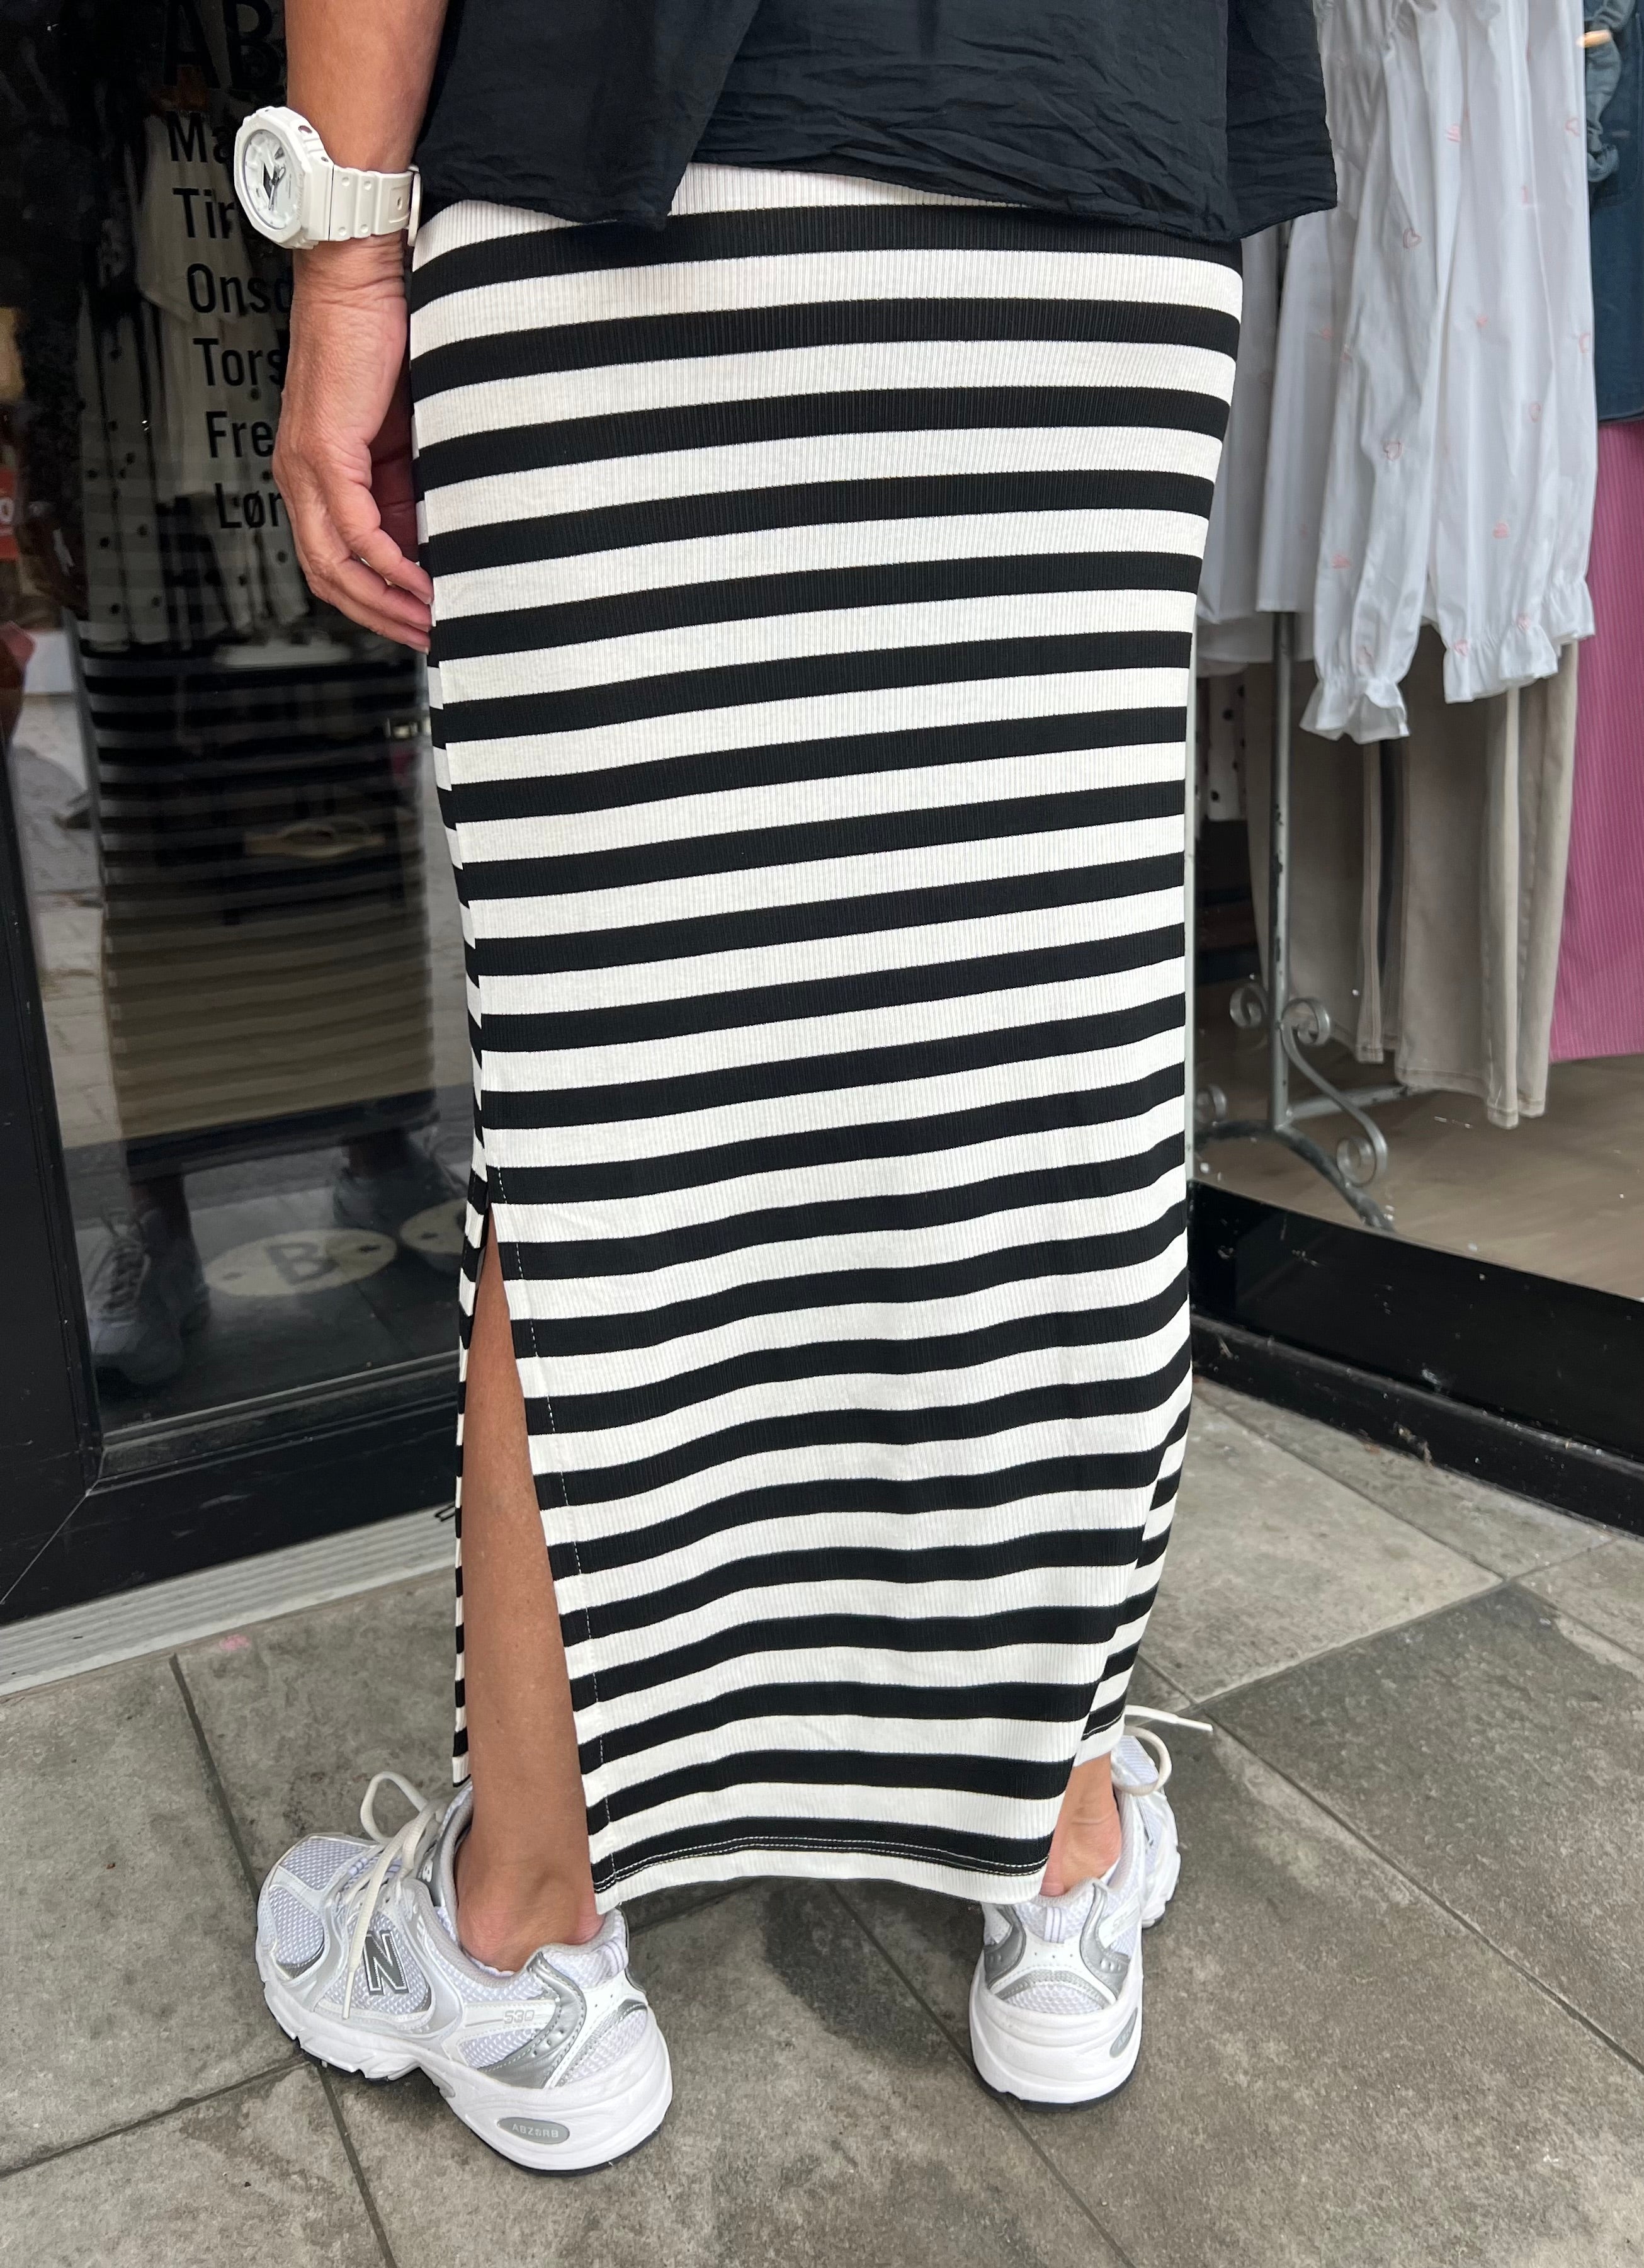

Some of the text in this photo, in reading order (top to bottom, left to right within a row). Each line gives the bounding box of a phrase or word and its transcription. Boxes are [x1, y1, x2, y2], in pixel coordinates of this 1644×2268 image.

[206, 411, 273, 458] Fre
[215, 482, 282, 528] Lør
[504, 2009, 535, 2025] 530
